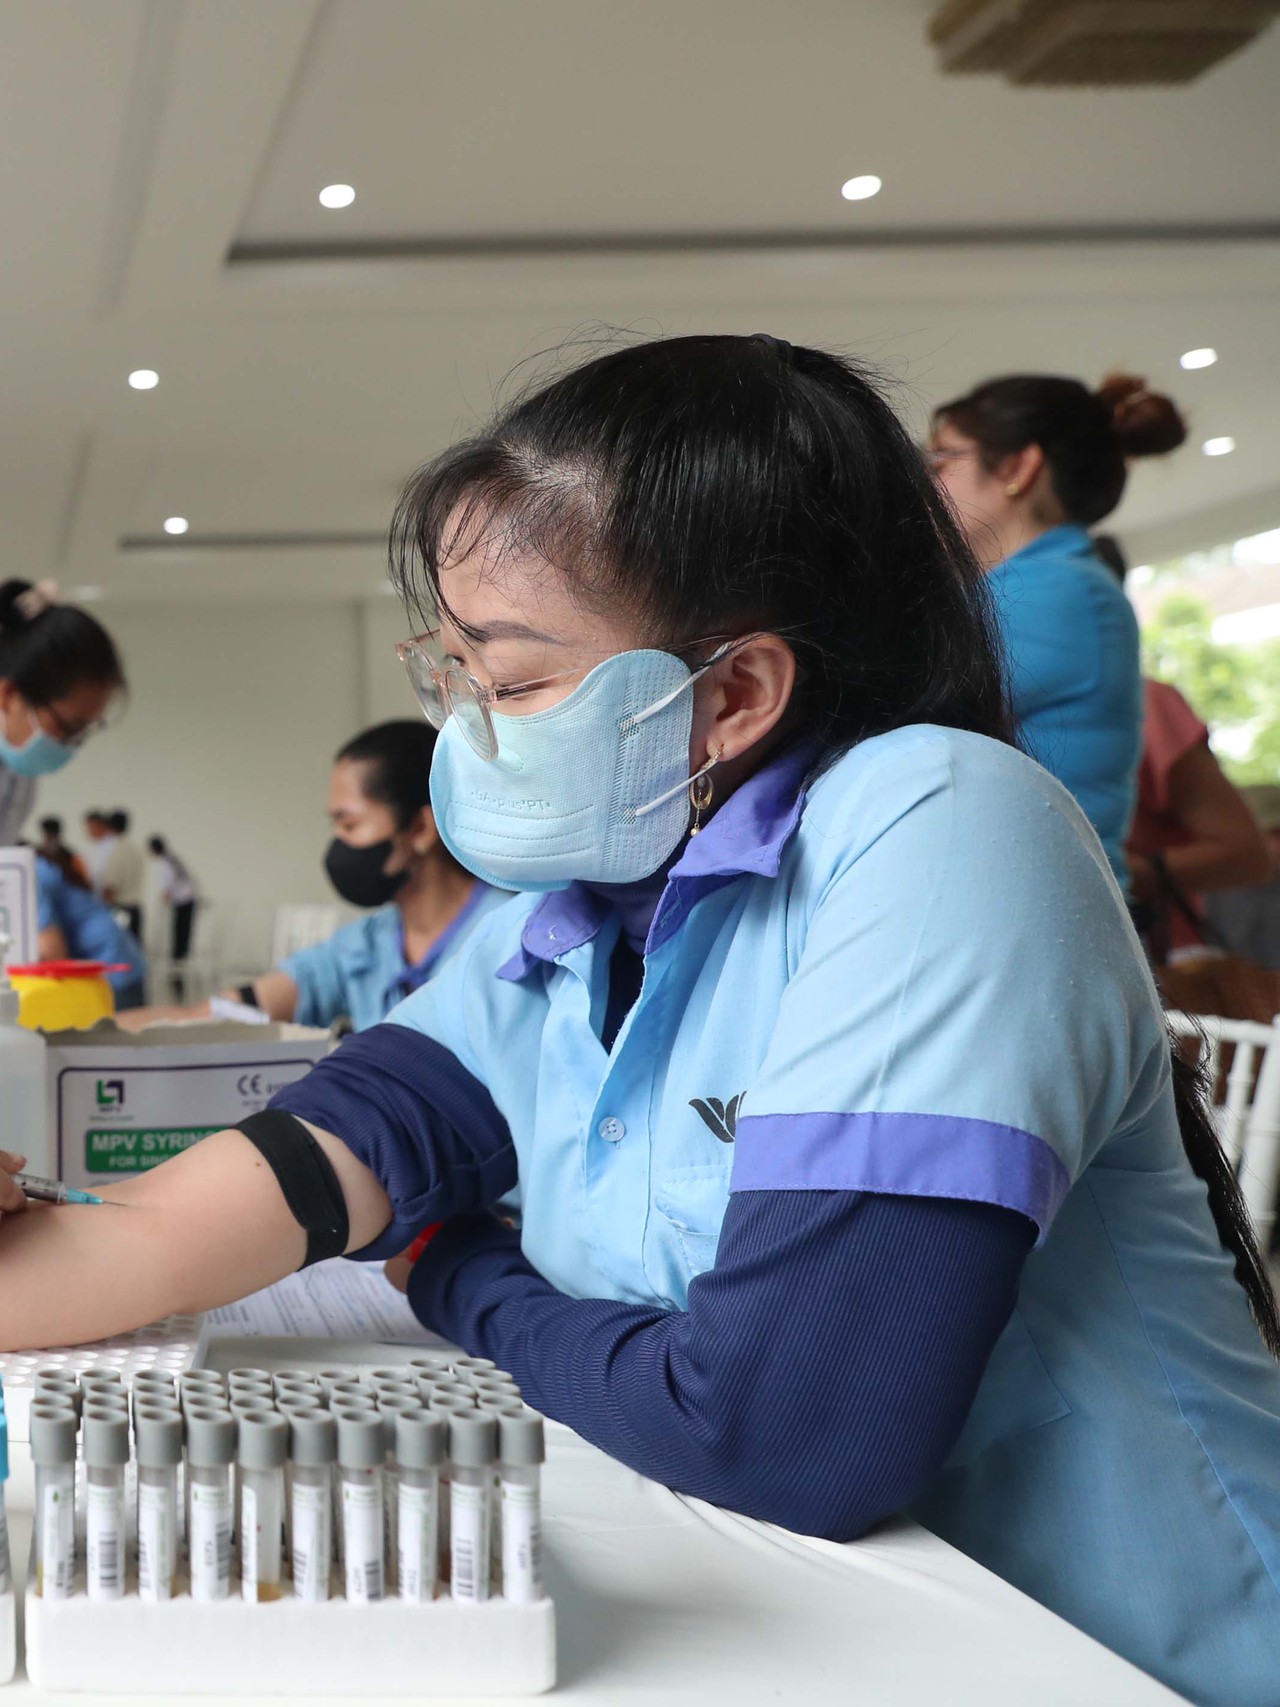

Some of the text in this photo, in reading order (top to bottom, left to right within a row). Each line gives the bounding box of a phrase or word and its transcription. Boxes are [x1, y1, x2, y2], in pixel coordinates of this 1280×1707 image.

[93, 1130, 215, 1151] MPV SYRIN
[108, 1154, 137, 1169] FOR
